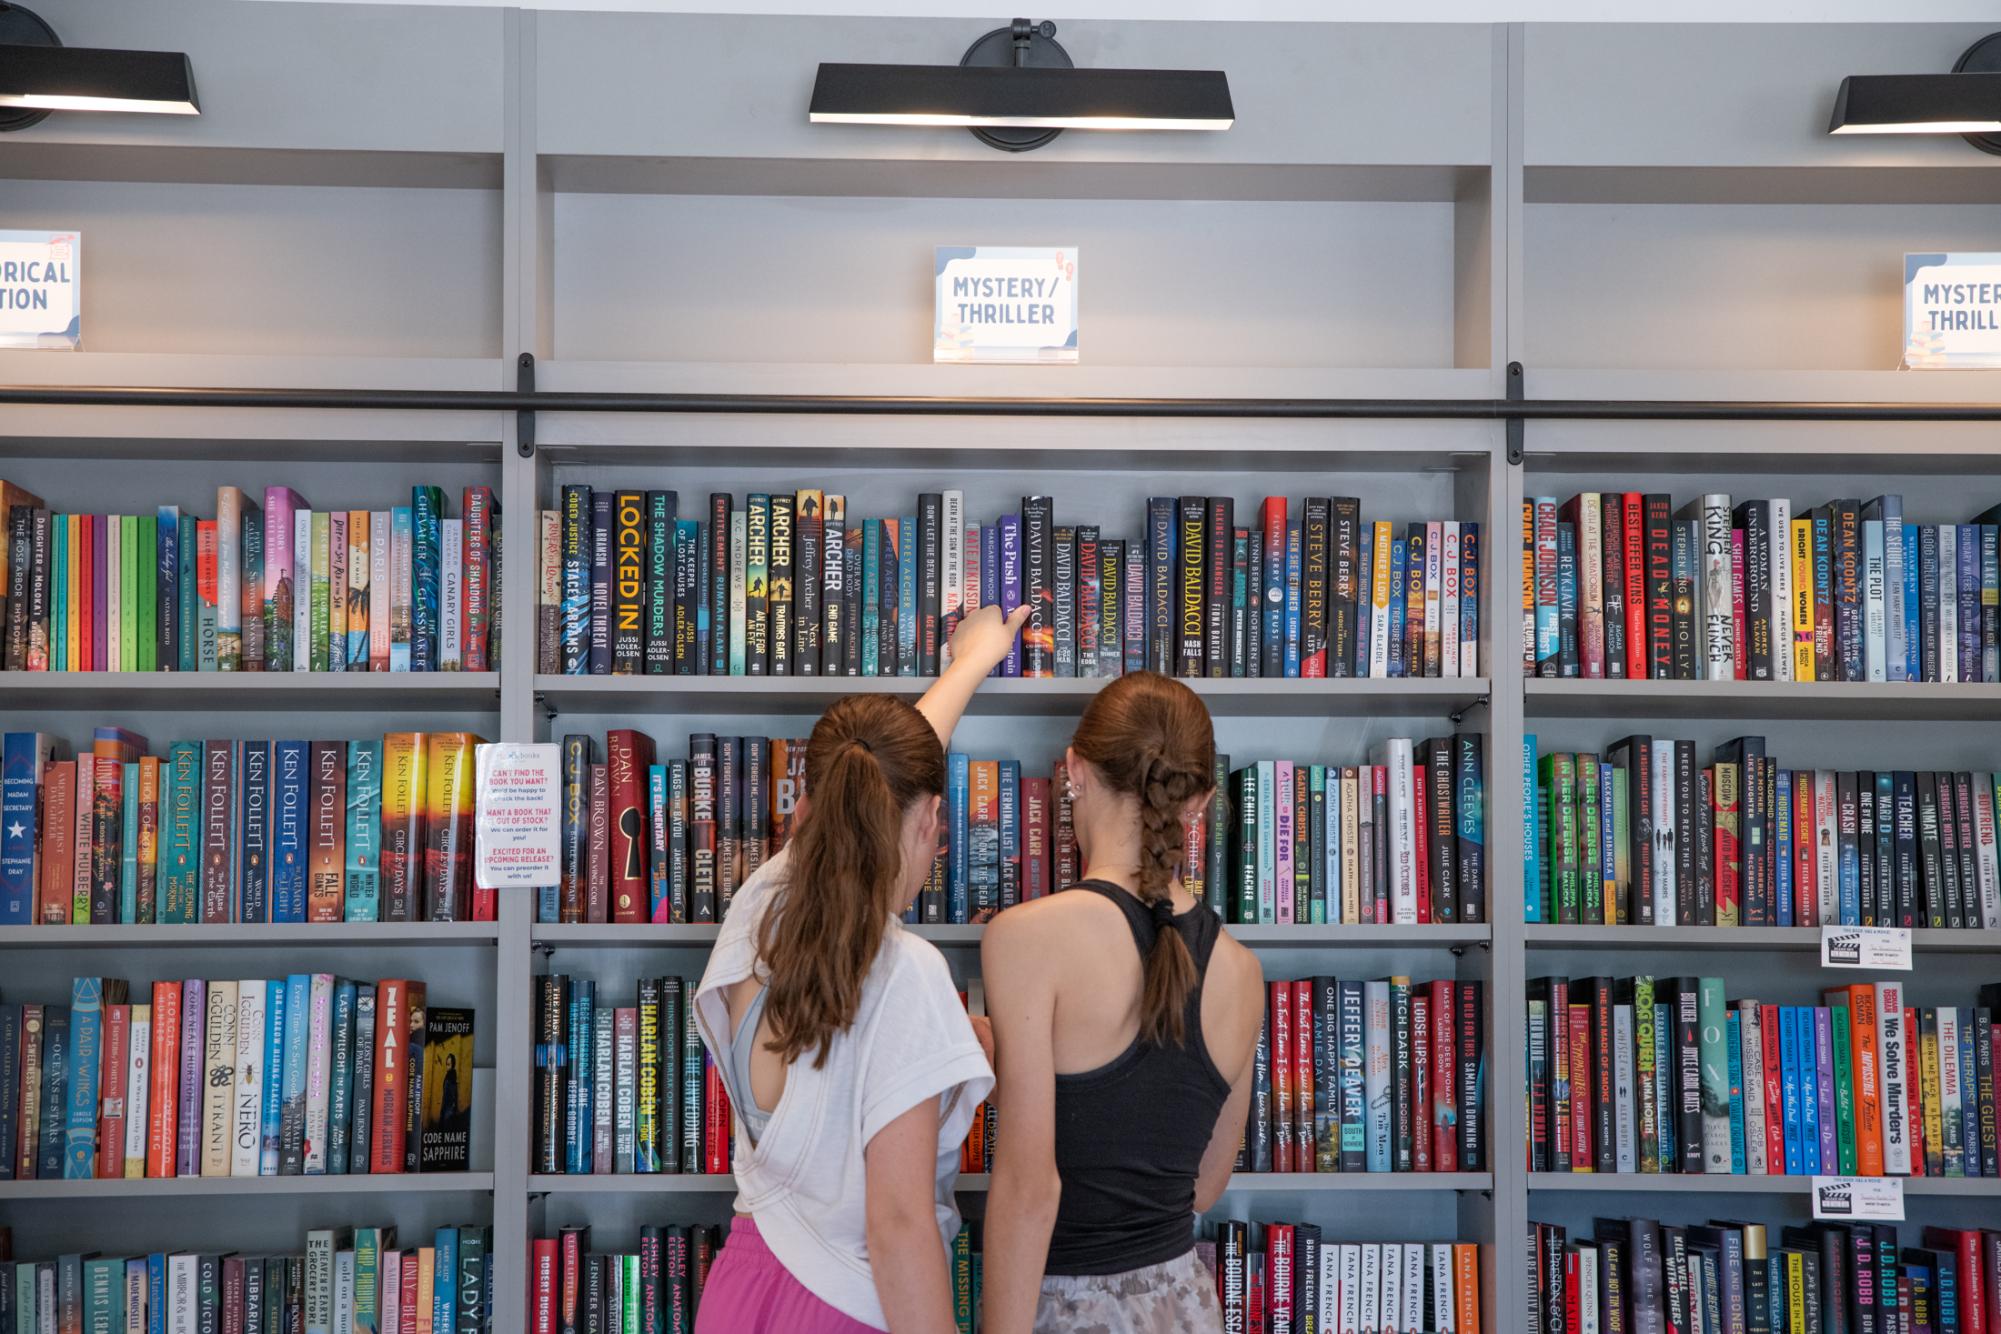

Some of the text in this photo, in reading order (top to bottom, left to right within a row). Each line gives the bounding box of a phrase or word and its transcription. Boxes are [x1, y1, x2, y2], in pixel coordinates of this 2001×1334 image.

[953, 277, 1059, 297] MYSTERY/
[958, 304, 1054, 324] THRILLER
[1928, 310, 1998, 330] THRILL
[469, 494, 481, 614] DAUGHTERS OF SHANDONG
[619, 495, 640, 629] LOCKED IN
[654, 495, 664, 636] THE SHADOW MURDERS
[749, 505, 765, 566] ARCHER
[1005, 523, 1016, 584] The Push
[1538, 503, 1557, 606] CRAIG JOHNSON
[1628, 504, 1642, 605] BEST OFFER WINS
[1677, 527, 1687, 594] STEPHEN KING
[1749, 508, 1758, 612] UNDERGROUND
[1816, 519, 1828, 605] DEAN KOONTZ
[15, 567, 23, 597] ARBOR
[716, 577, 724, 621] RUMAAN
[803, 535, 815, 610] Jeffrey Archer
[1184, 521, 1202, 635] DAVID BALDACCI
[1561, 556, 1575, 620] REYKJAVÍK
[1651, 529, 1670, 665] DEAD MONEY
[1869, 557, 1881, 601] THE PLOT
[416, 588, 426, 666] GLASSMAKER
[446, 572, 455, 648] CANARY GIRLS
[567, 561, 580, 653] STACEY ABRAMS
[593, 582, 607, 648] NOVEL THREAT
[798, 616, 807, 652] in Line
[809, 623, 818, 647] Next
[828, 605, 837, 643] END GAME
[1211, 603, 1221, 660] FIONA BARTON
[1391, 607, 1400, 664] TREASURE STATE
[203, 618, 214, 663] HORSE
[1437, 750, 1449, 767] THE
[1463, 741, 1474, 833] ANN CLEEVES
[282, 749, 299, 850] KEN FOLLETT
[592, 768, 606, 850] DAN BROWN
[695, 767, 712, 893] BURKE CLETE
[1002, 788, 1013, 850] TERMINAL LIST
[1437, 770, 1451, 836] GHOSTWRITER
[1586, 778, 1597, 864] HER DEFENSE
[1898, 795, 1911, 840] TEACHER
[77, 812, 90, 912] WHITE MULBERRY
[1244, 865, 1253, 900] REACHER
[1442, 870, 1450, 898] CLARK
[1327, 1014, 1335, 1032] BIG
[1327, 1036, 1335, 1071] HAPPY
[1344, 988, 1361, 1116] JEFFERY DEAVER
[1398, 984, 1407, 1069] PITCH DARK
[335, 1023, 347, 1119] TWILIGHT IN PARIS
[640, 1005, 656, 1114] HARLAN COBEN
[1601, 1057, 1608, 1069] OF
[1884, 1018, 1903, 1144] We Solve Murders
[1944, 1046, 1956, 1095] DILEMMA
[211, 1093, 225, 1152] TYRANT
[238, 1094, 257, 1149] NERO
[1465, 1062, 1476, 1148] SAMANTHA DOWNING
[423, 1132, 467, 1143] CODE NAME
[423, 1147, 465, 1161] SAPPHIRE
[319, 1250, 328, 1283] HEAVEN
[1306, 1240, 1314, 1310] BRIAN FREEMAN
[1410, 1251, 1418, 1278] TANA
[1858, 1271, 1873, 1304] ROBB
